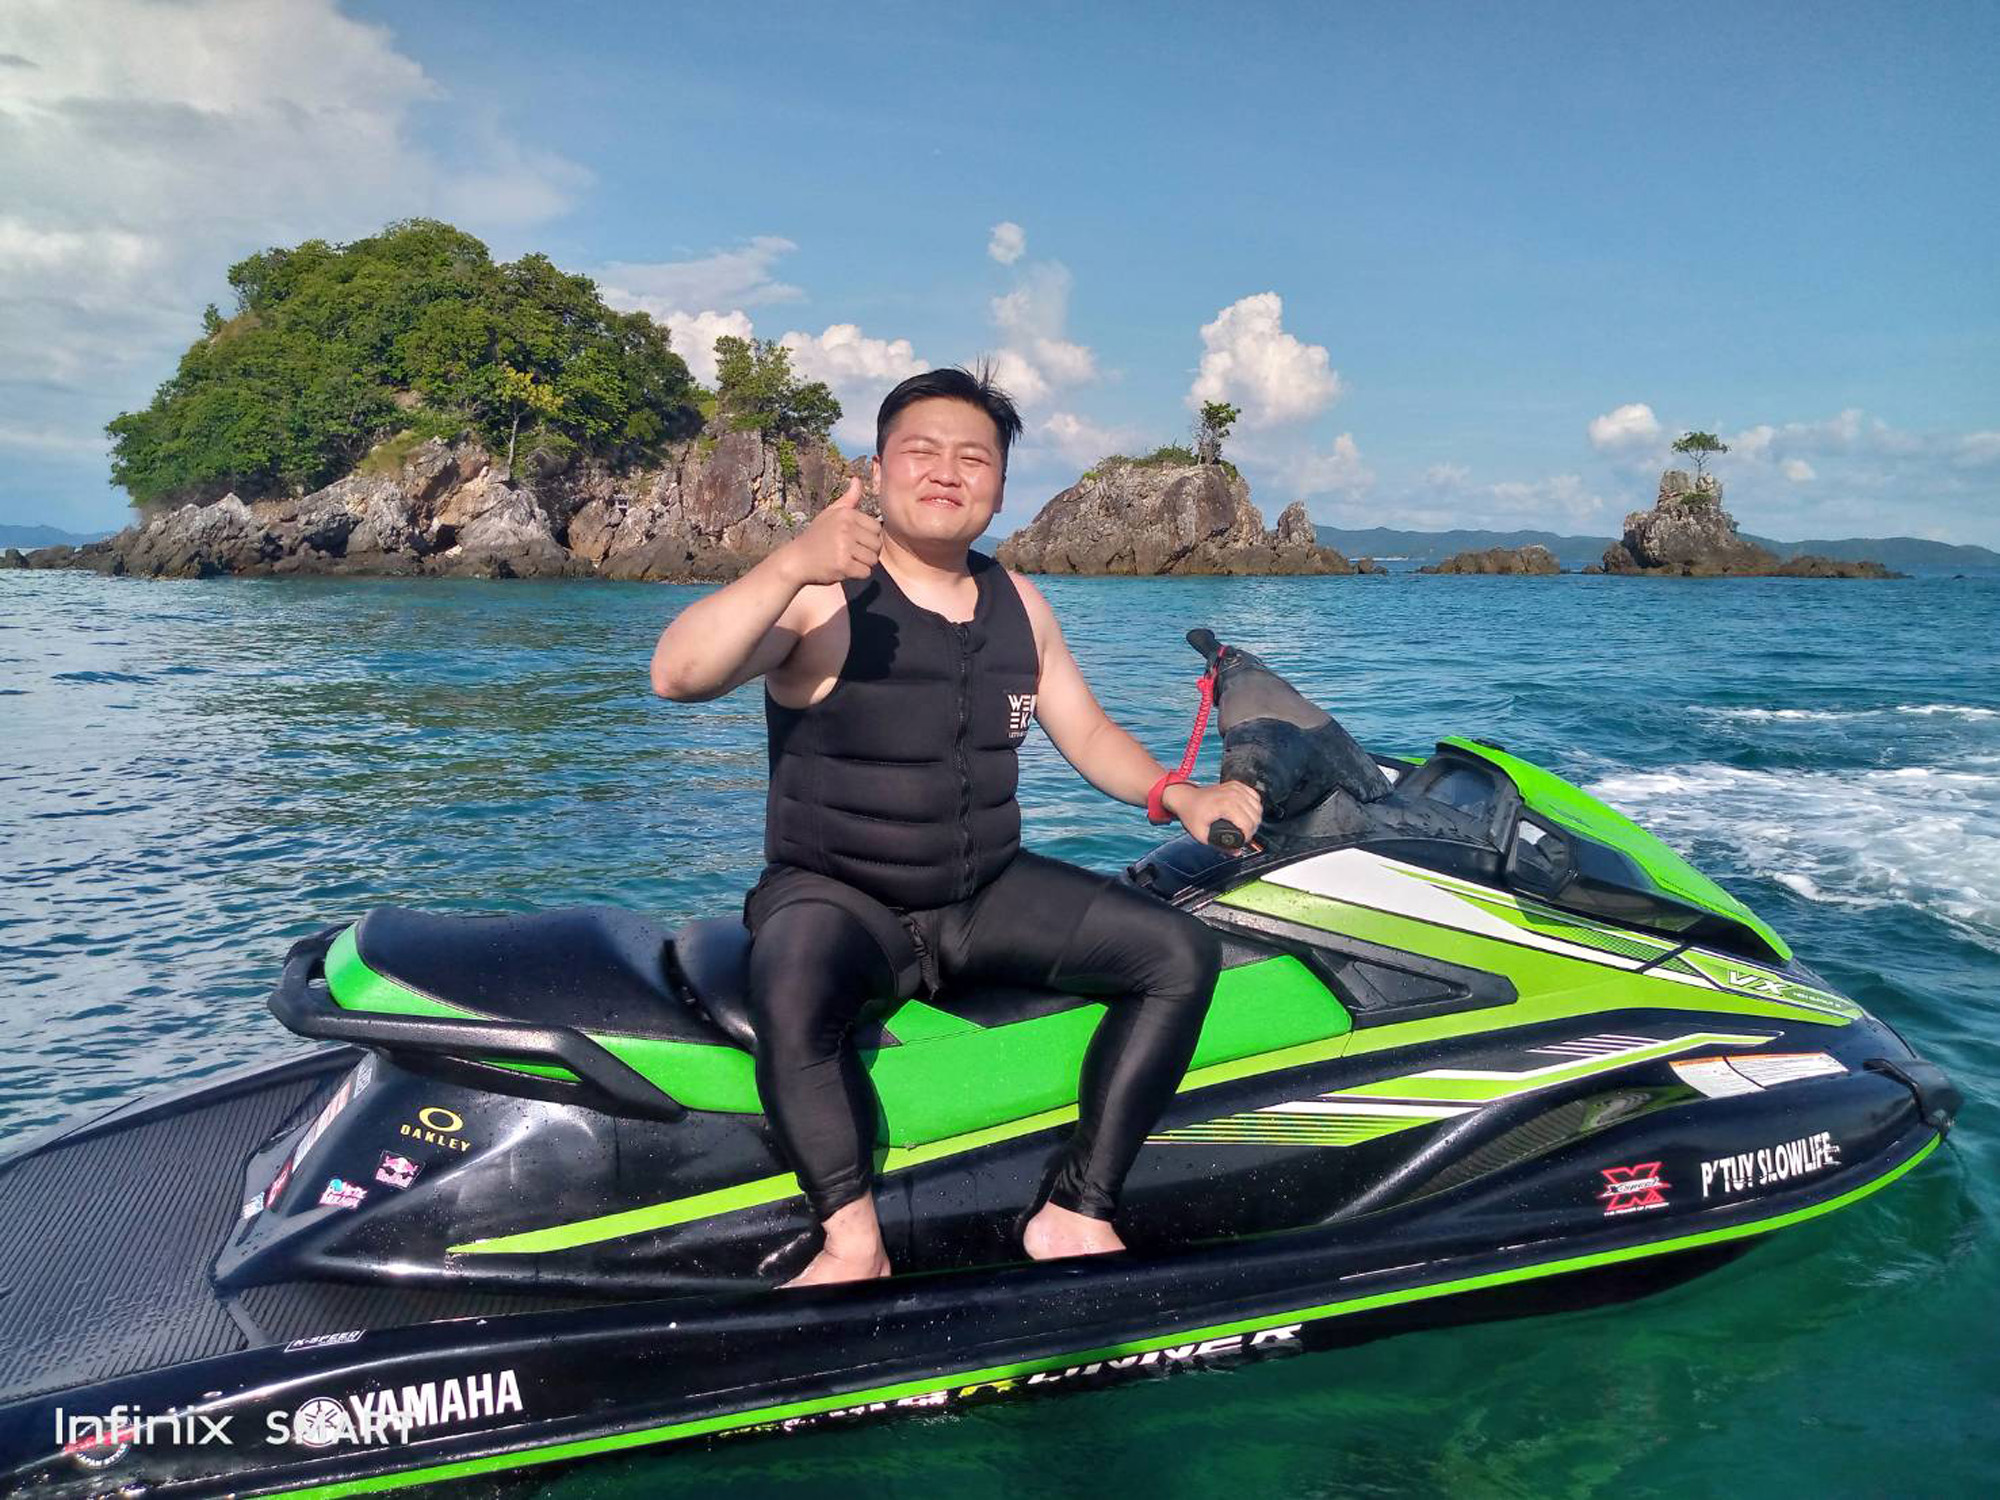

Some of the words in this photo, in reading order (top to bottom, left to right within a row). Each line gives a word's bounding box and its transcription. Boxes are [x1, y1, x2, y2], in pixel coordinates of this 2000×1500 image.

[1729, 970, 1788, 997] VX
[400, 1124, 471, 1152] OAKLEY
[1757, 1131, 1841, 1186] SLOWLIFE
[349, 1369, 524, 1437] YAMAHA
